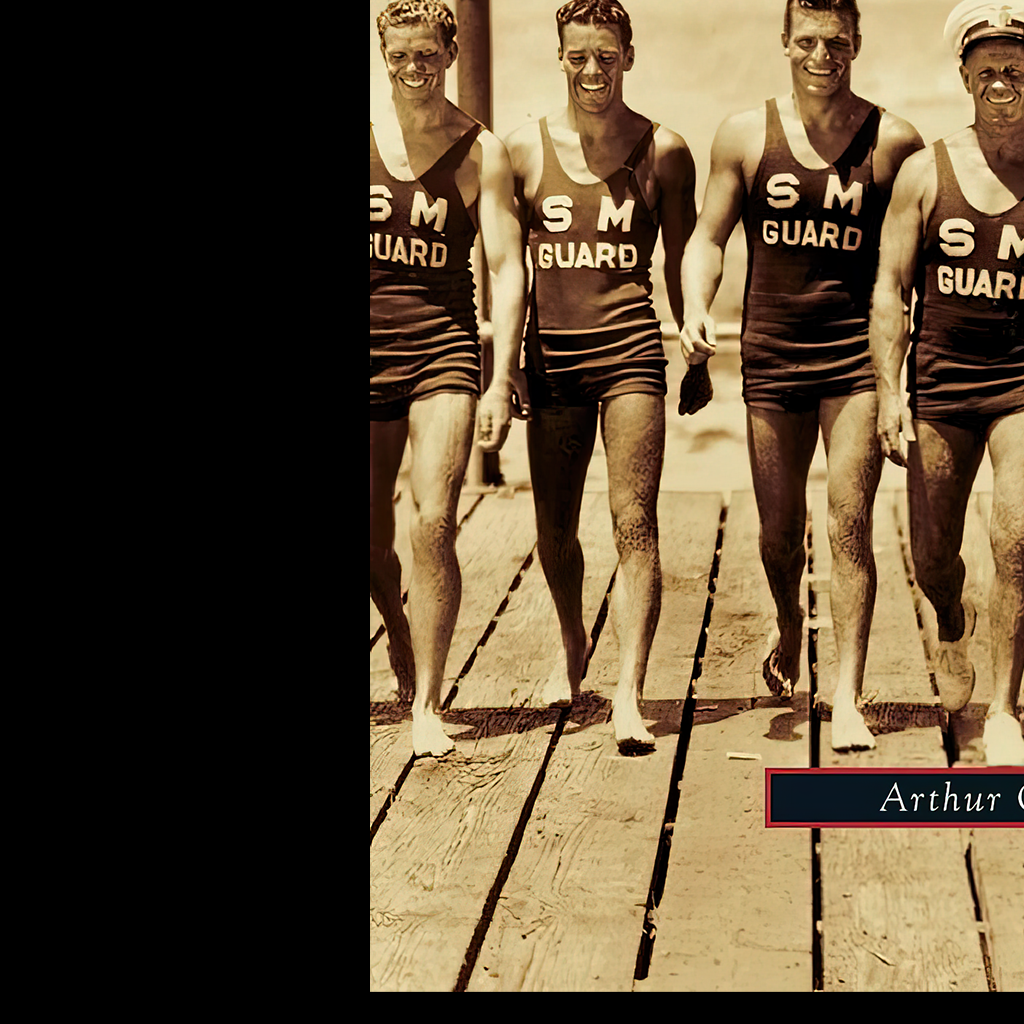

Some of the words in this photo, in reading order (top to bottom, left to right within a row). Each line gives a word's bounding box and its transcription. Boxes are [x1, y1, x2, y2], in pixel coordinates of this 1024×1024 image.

[410, 191, 448, 232] M
[765, 172, 801, 209] S
[823, 174, 863, 216] M
[542, 195, 572, 233] S
[596, 194, 635, 233] M
[369, 233, 448, 268] UARD
[762, 219, 862, 252] GUARD
[938, 217, 976, 258] S
[538, 241, 639, 270] GUARD
[878, 780, 1001, 814] Arthur
